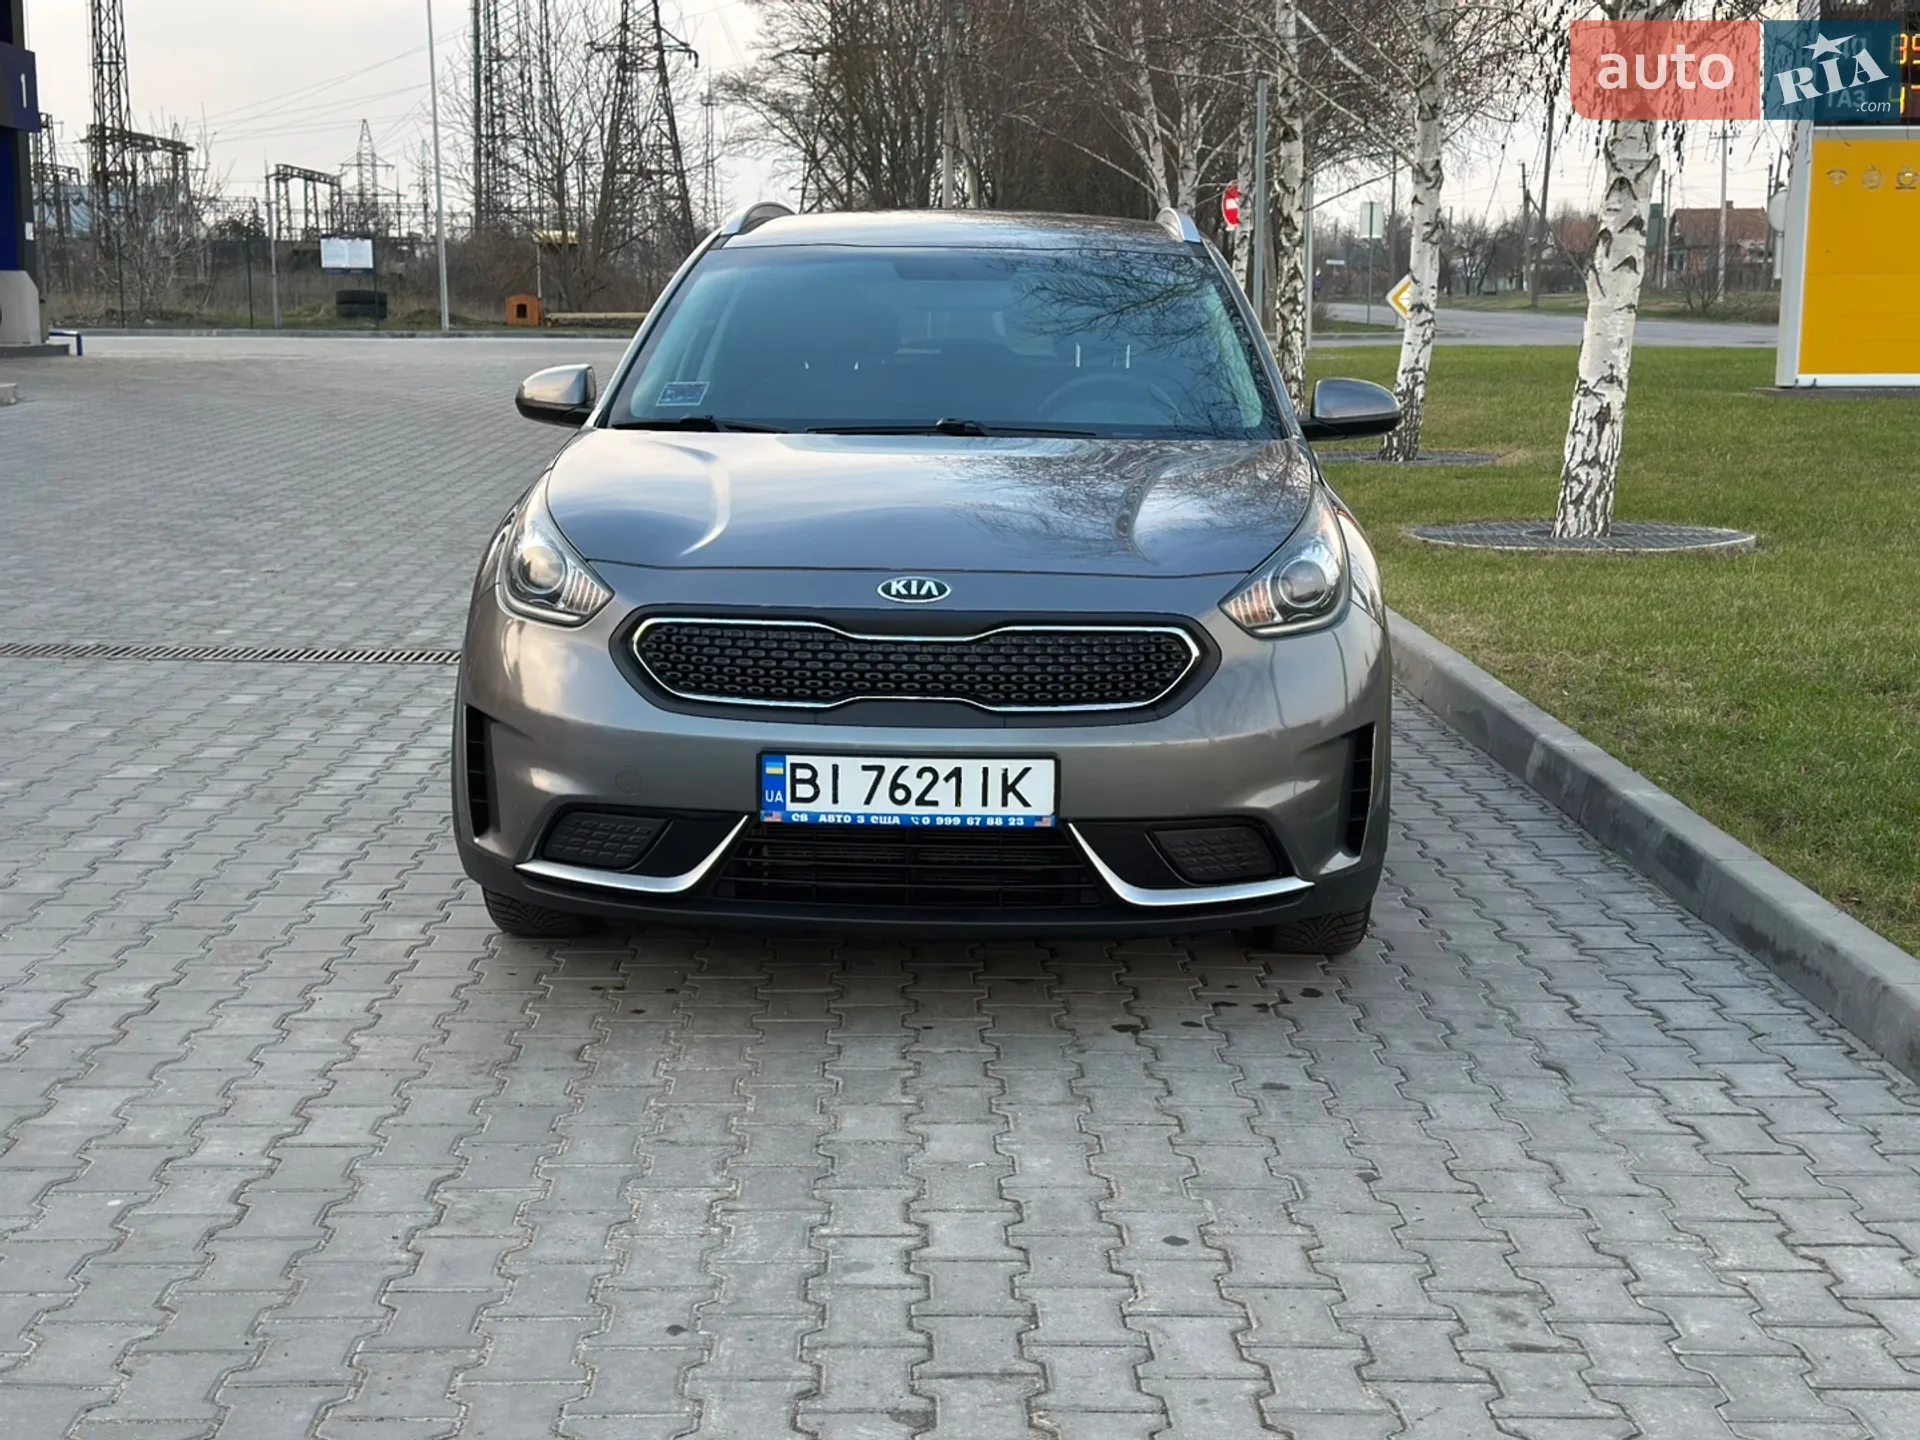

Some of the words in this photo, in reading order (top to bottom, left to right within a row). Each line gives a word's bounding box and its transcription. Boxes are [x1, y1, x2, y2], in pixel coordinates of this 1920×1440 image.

[890, 579, 939, 596] KIA
[789, 762, 839, 805] BI
[861, 764, 963, 808] 7621
[981, 766, 1033, 808] IK
[765, 789, 784, 803] UA
[818, 814, 852, 823] АВТО
[870, 815, 901, 825] США
[936, 816, 961, 826] 999
[1008, 817, 1024, 827] 23
